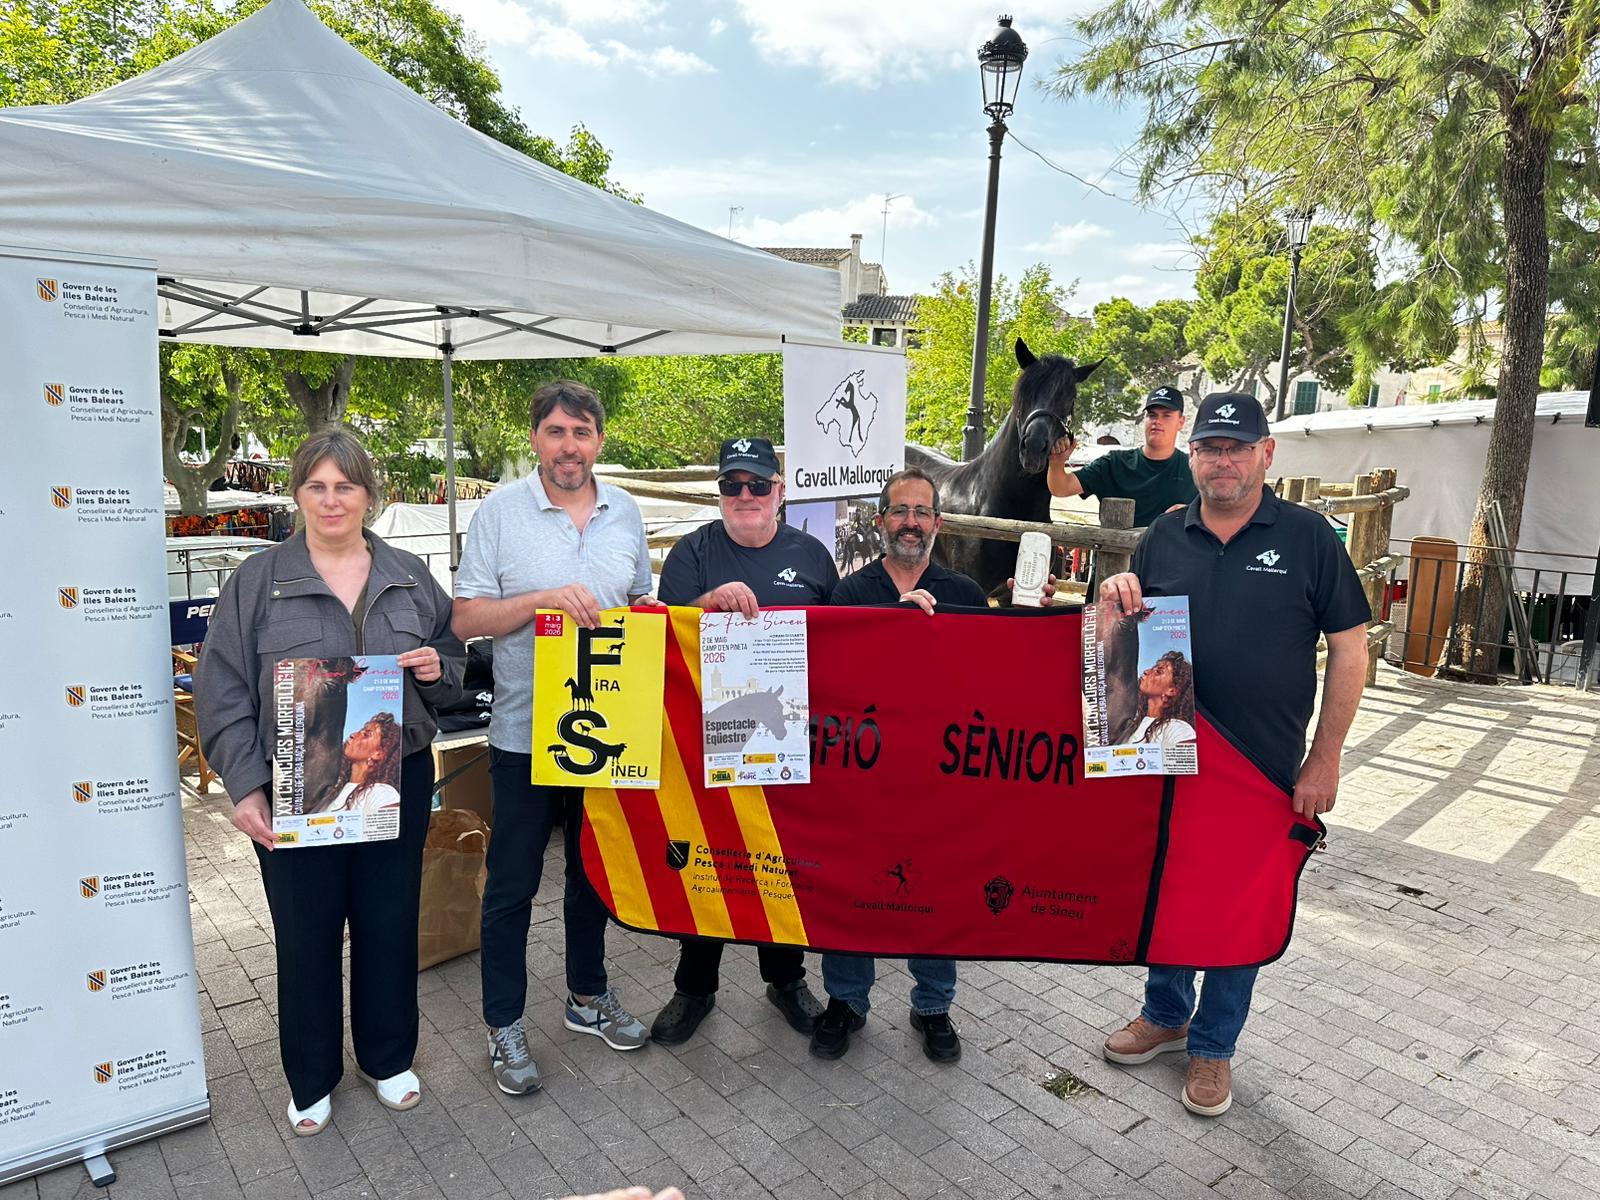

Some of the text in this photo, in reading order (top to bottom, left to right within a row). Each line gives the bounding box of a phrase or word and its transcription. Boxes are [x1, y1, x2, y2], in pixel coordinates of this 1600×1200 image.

[85, 293, 118, 302] Balears
[64, 303, 102, 311] Conselleria
[65, 311, 85, 319] Pesca
[69, 386, 97, 394] Govern
[92, 396, 124, 404] Balears
[795, 464, 894, 488] Cavall Mallorquí
[724, 612, 758, 634] Fira
[704, 652, 726, 663] 2026
[90, 693, 142, 702] Illes Balears
[1085, 676, 1099, 726] CONCURS
[706, 718, 756, 732] Espectacle
[706, 732, 746, 746] Eqüestre
[1087, 730, 1100, 746] XXI
[940, 709, 1078, 786] SÈNIOR
[277, 740, 293, 794] CONCURS
[118, 787, 149, 795] Balears
[142, 801, 164, 809] Natural
[276, 797, 292, 816] XXI
[696, 845, 752, 858] Conselleria
[694, 858, 723, 868] Pesca
[735, 862, 757, 872] Medi
[762, 864, 798, 876] Natural
[104, 879, 155, 891] Illes Balears
[1022, 886, 1098, 904] Ajuntament
[1031, 903, 1084, 920] de Sineu
[110, 966, 136, 975] Govern
[110, 970, 161, 984] Illes Balears
[2, 1016, 28, 1028] Natural
[117, 1056, 143, 1067] Govern
[117, 1058, 167, 1075] Illes Balears
[119, 1082, 138, 1091] Pesca
[160, 1070, 182, 1079] Natural
[5, 1089, 18, 1098] les
[10, 1110, 36, 1122] Natural
